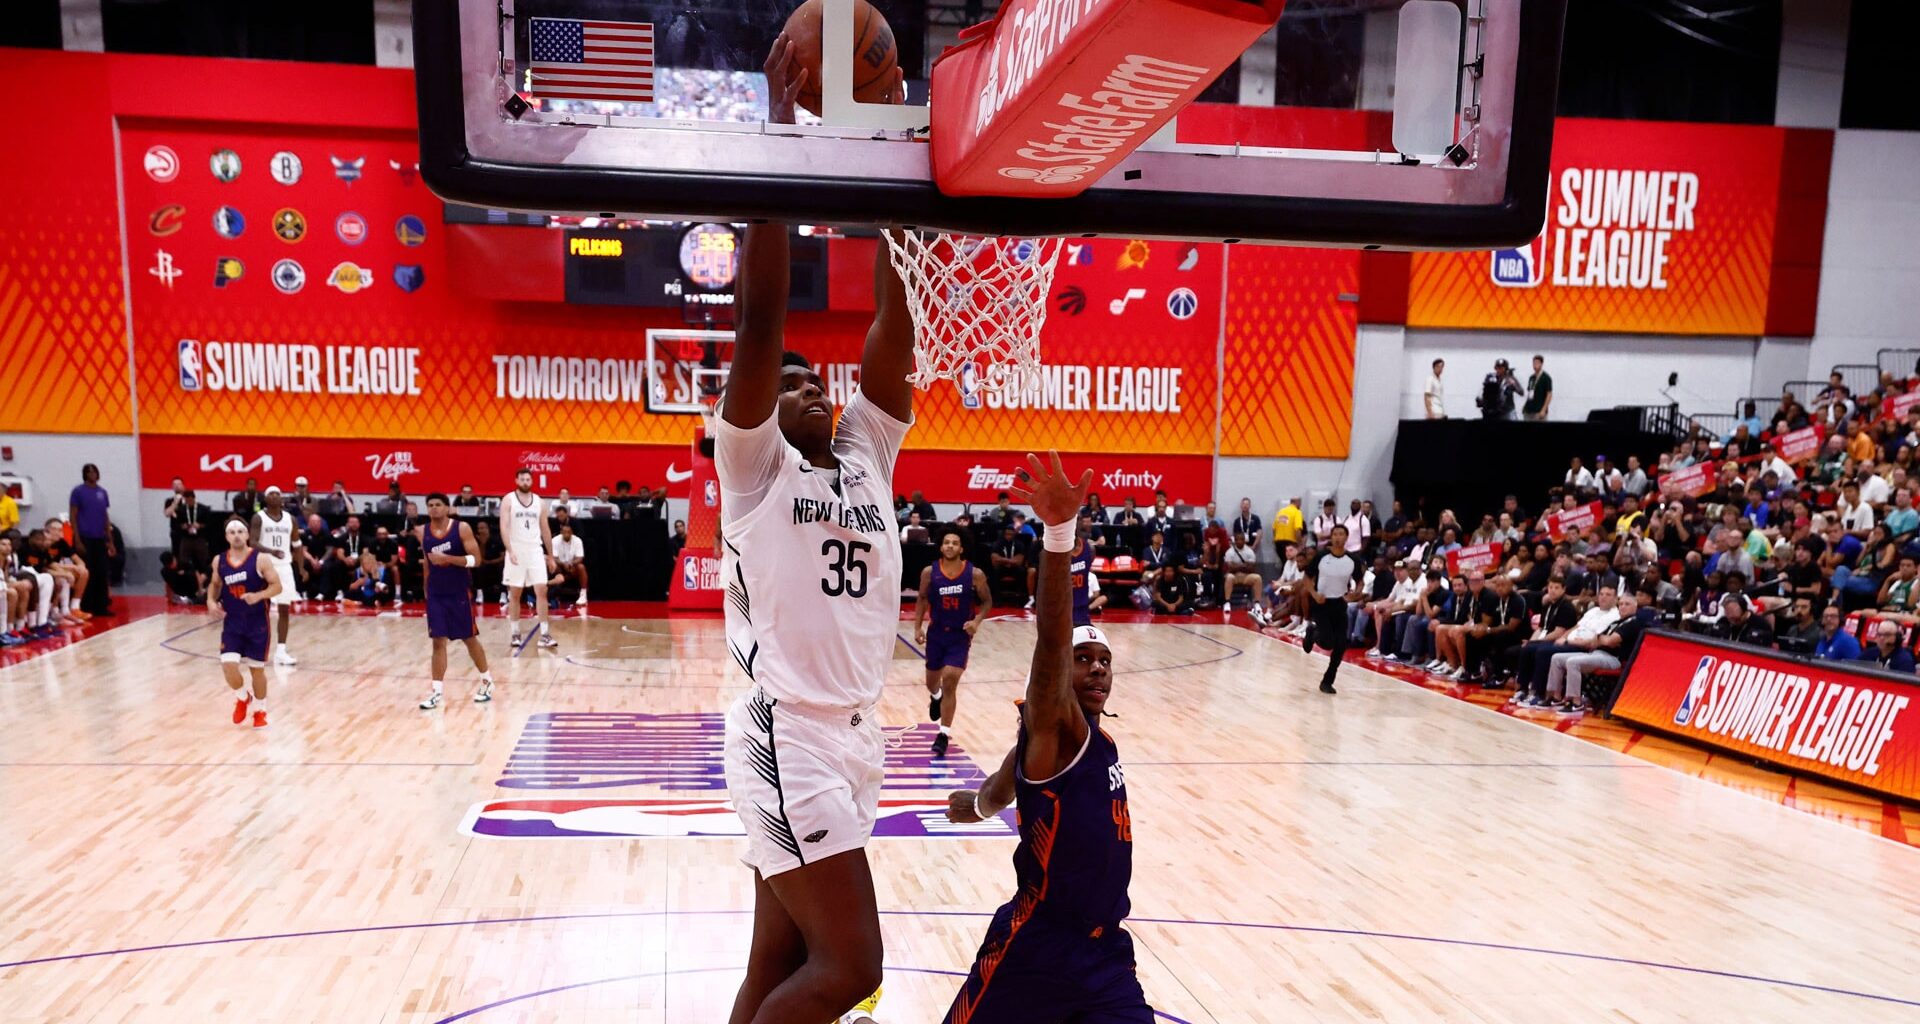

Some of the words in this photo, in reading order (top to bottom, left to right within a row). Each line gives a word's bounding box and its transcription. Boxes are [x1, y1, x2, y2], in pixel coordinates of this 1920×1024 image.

[1557, 167, 1700, 231] SUMMER
[1499, 258, 1524, 278] NBA
[1552, 228, 1672, 289] LEAGUE
[205, 341, 322, 393] SUMMER
[326, 345, 422, 396] LEAGUE
[986, 363, 1092, 412] SUMMER
[1096, 366, 1182, 413] LEAGUE
[365, 453, 420, 481] Vegas
[526, 463, 561, 472] ULTRA
[1102, 468, 1163, 491] xfinity
[793, 497, 834, 525] NEW
[272, 535, 283, 548] 10
[821, 538, 872, 599] 35
[1694, 660, 1811, 752] SUMMER
[1787, 680, 1910, 776] LEAGUE
